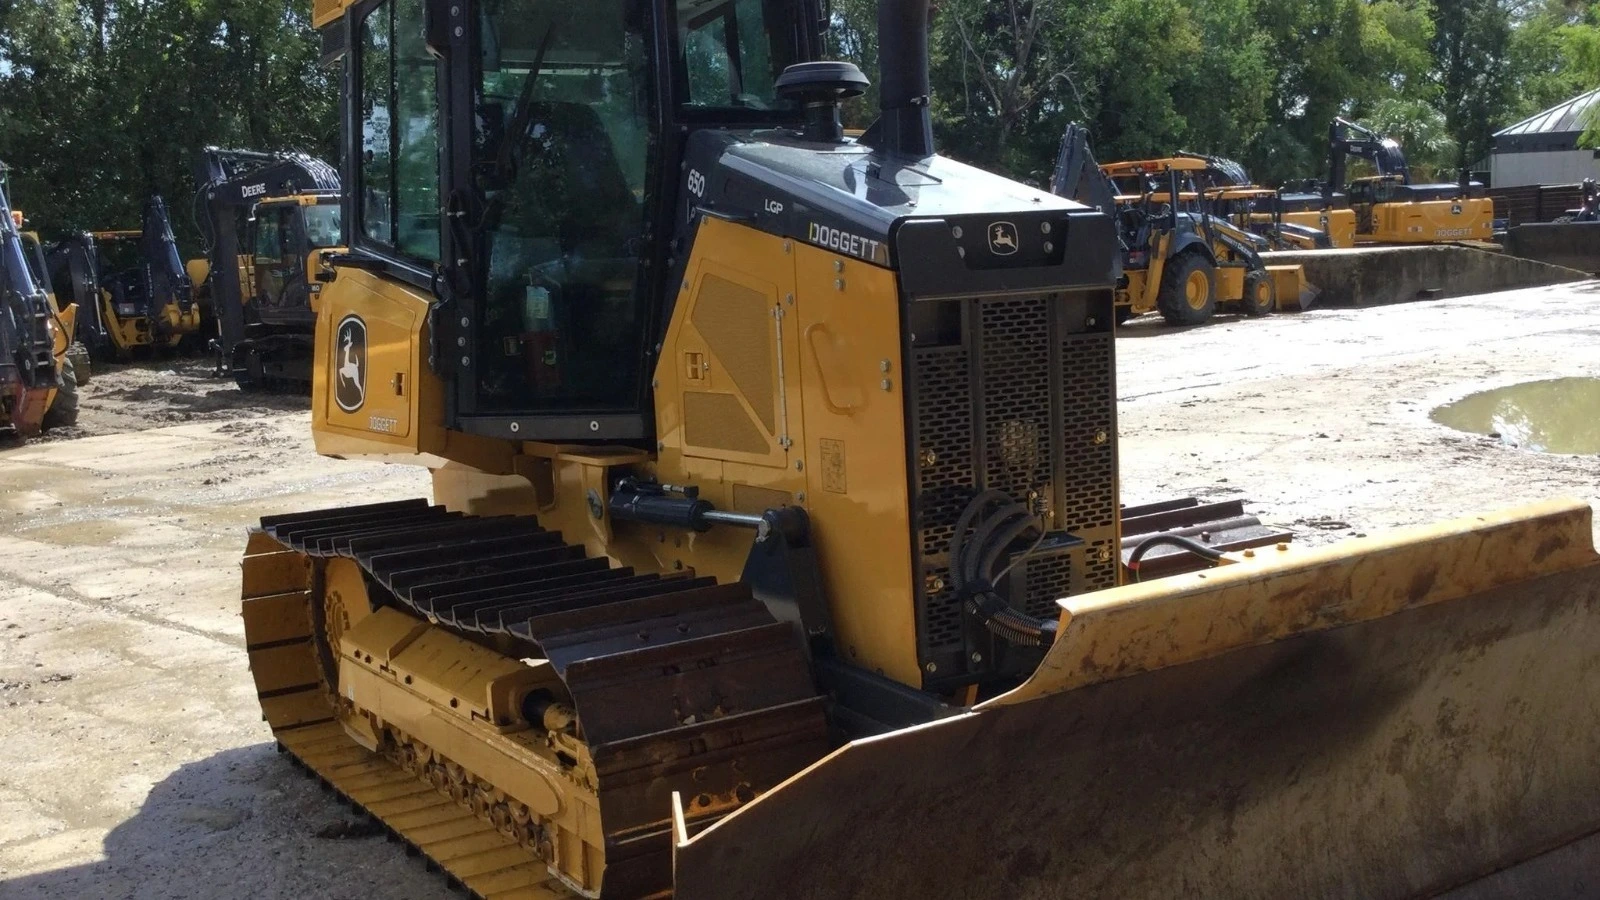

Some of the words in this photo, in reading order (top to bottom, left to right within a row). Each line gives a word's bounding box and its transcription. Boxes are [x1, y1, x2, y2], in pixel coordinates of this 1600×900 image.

[241, 183, 266, 198] DEERE
[688, 169, 705, 198] 650
[765, 199, 783, 214] LGP
[809, 222, 879, 260] DOGGETT
